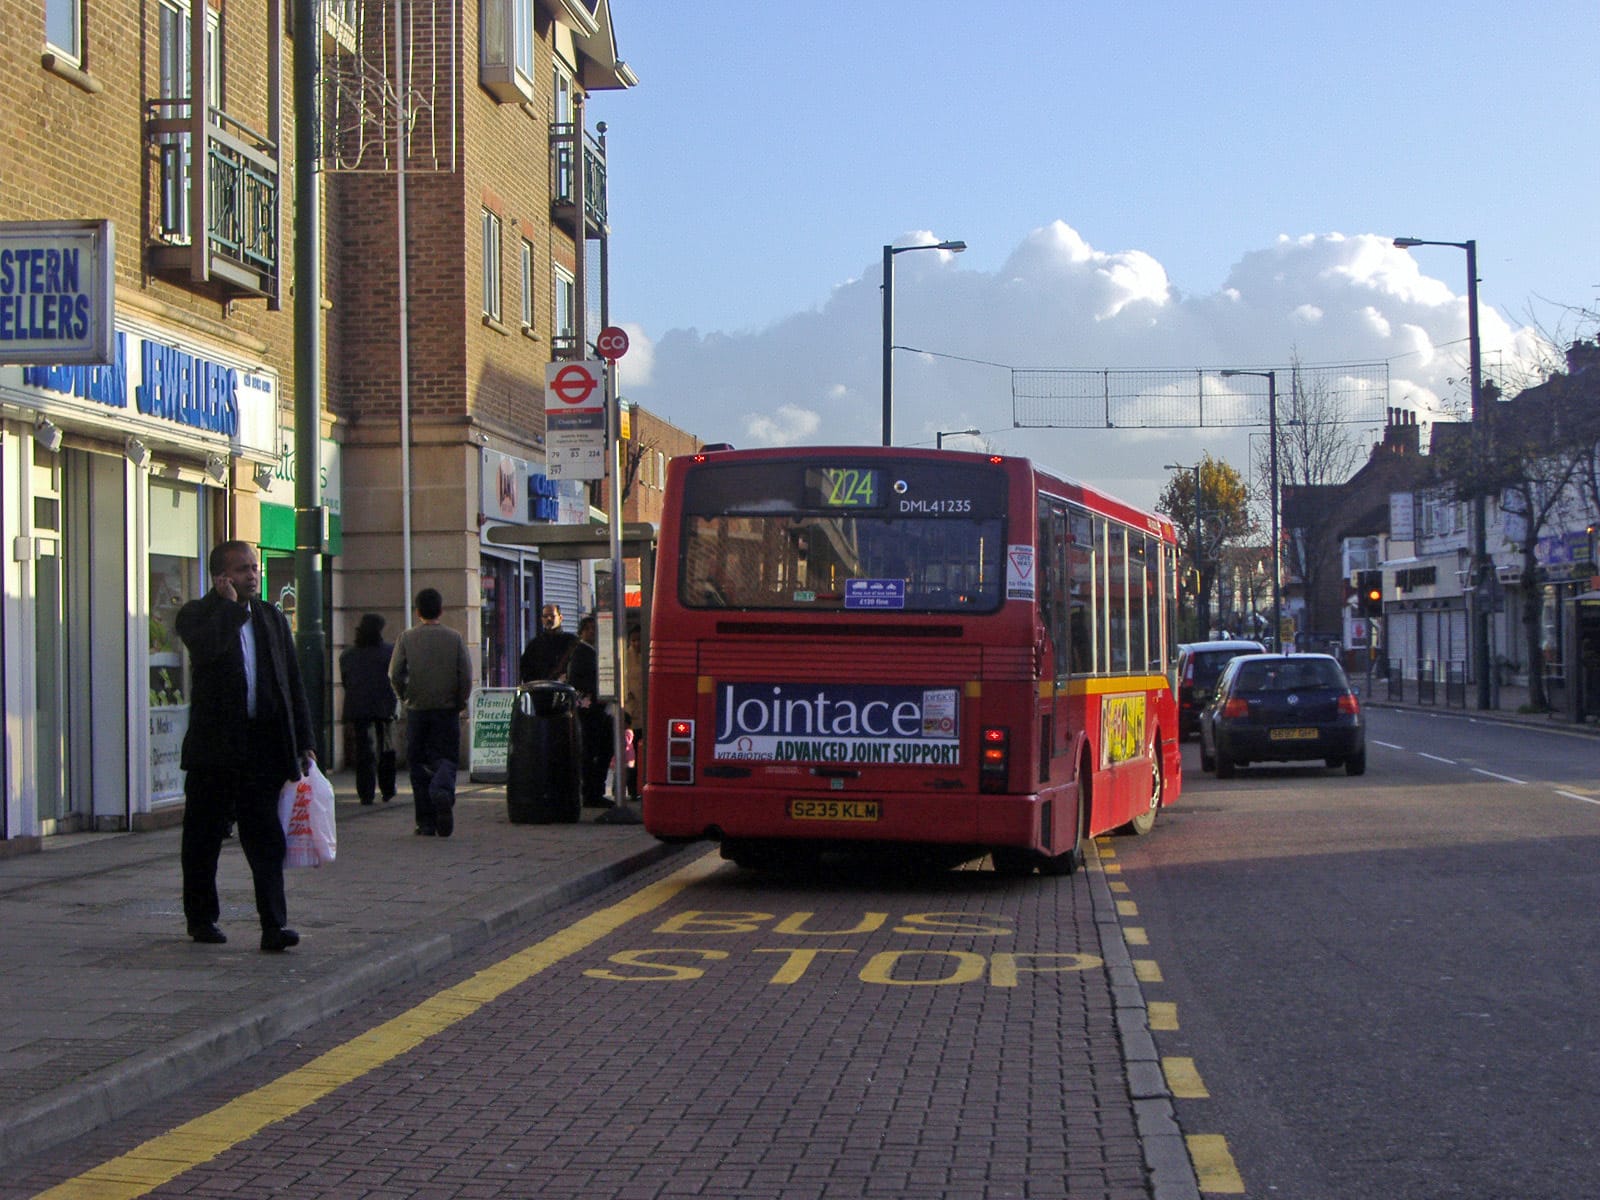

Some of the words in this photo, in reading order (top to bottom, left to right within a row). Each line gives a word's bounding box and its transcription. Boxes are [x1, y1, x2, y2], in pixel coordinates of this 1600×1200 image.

[136, 339, 239, 437] JEWELLERS
[828, 469, 874, 505] 224
[899, 500, 972, 513] DML41235
[718, 685, 921, 741] Jointace
[717, 751, 774, 761] VITABIOTICS
[774, 741, 848, 762] ADVANCED
[850, 742, 892, 763] JOINT
[893, 743, 960, 764] SUPPORT
[794, 802, 839, 817] S235
[842, 802, 876, 817] KLM
[650, 910, 1013, 936] BUS
[581, 947, 1104, 988] STOP
